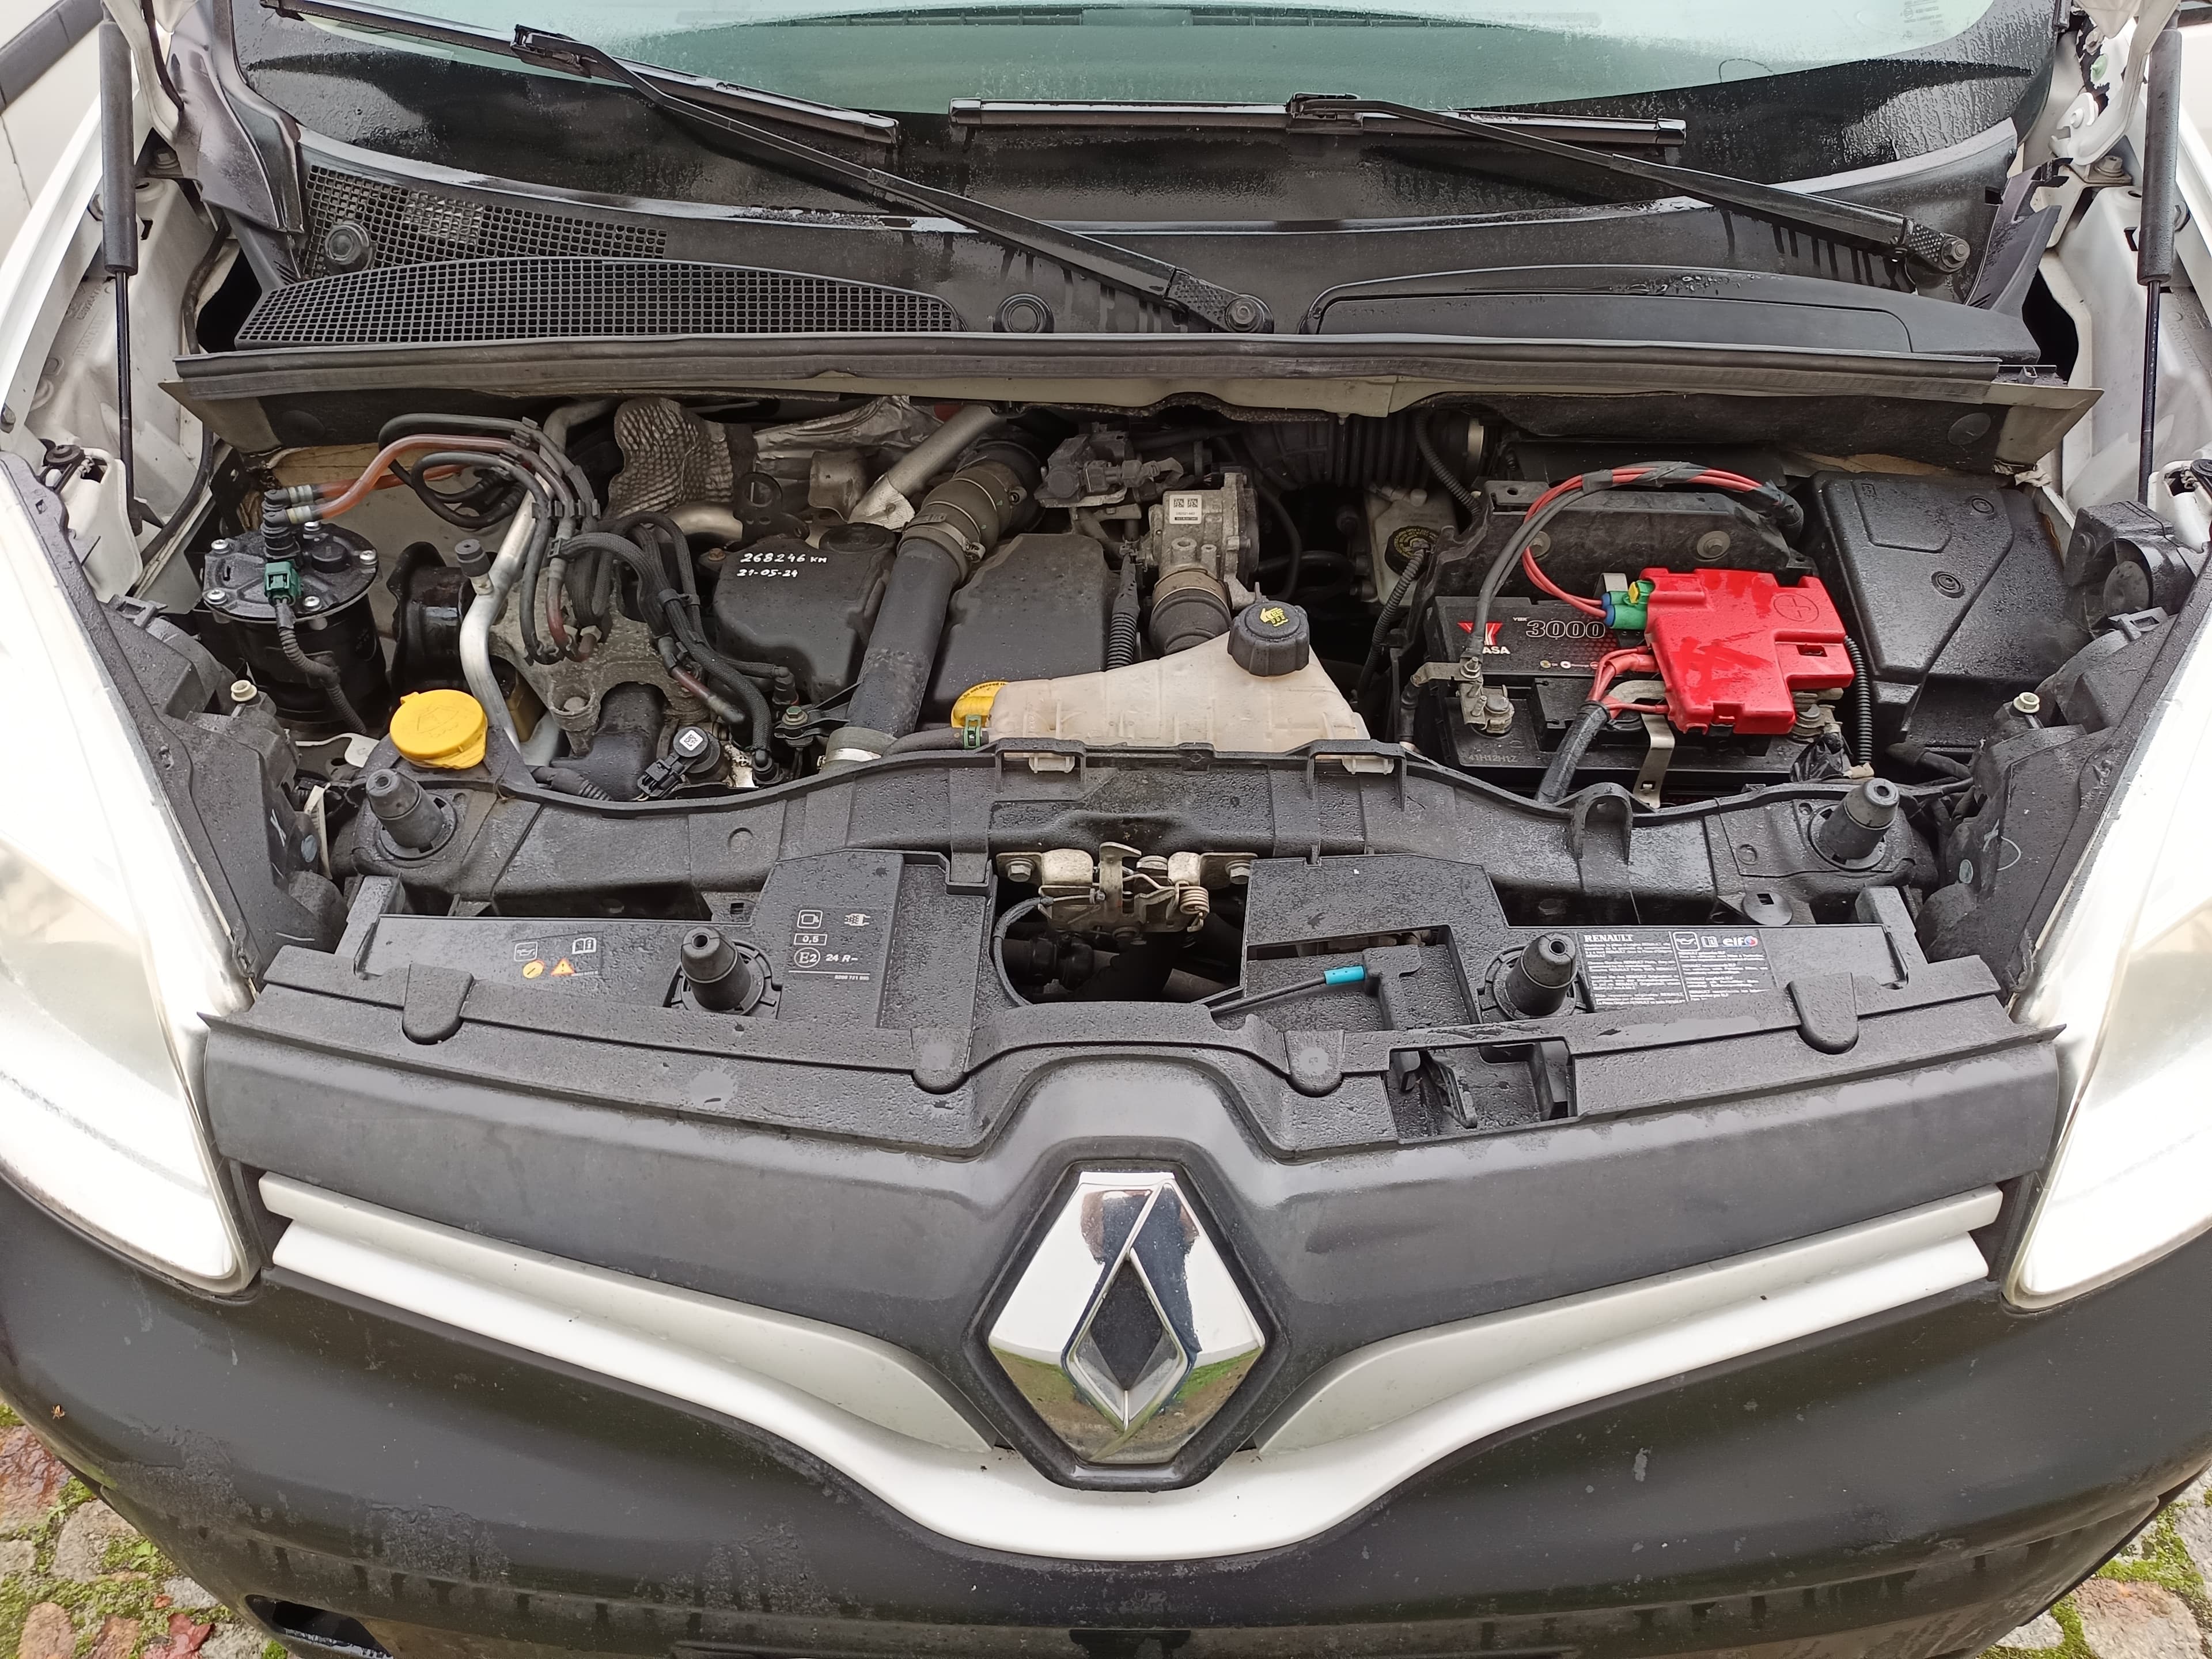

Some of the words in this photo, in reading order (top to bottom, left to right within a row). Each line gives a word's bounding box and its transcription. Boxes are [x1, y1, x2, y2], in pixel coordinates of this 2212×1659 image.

[740, 553, 806, 562] 268246
[737, 569, 798, 577] 21-05-24
[1527, 620, 1605, 638] 3000
[1482, 646, 1510, 654] ASA
[802, 935, 819, 944] 0,5
[1584, 934, 1634, 942] RENAULT
[1722, 937, 1744, 946] elf
[798, 952, 817, 964] E2
